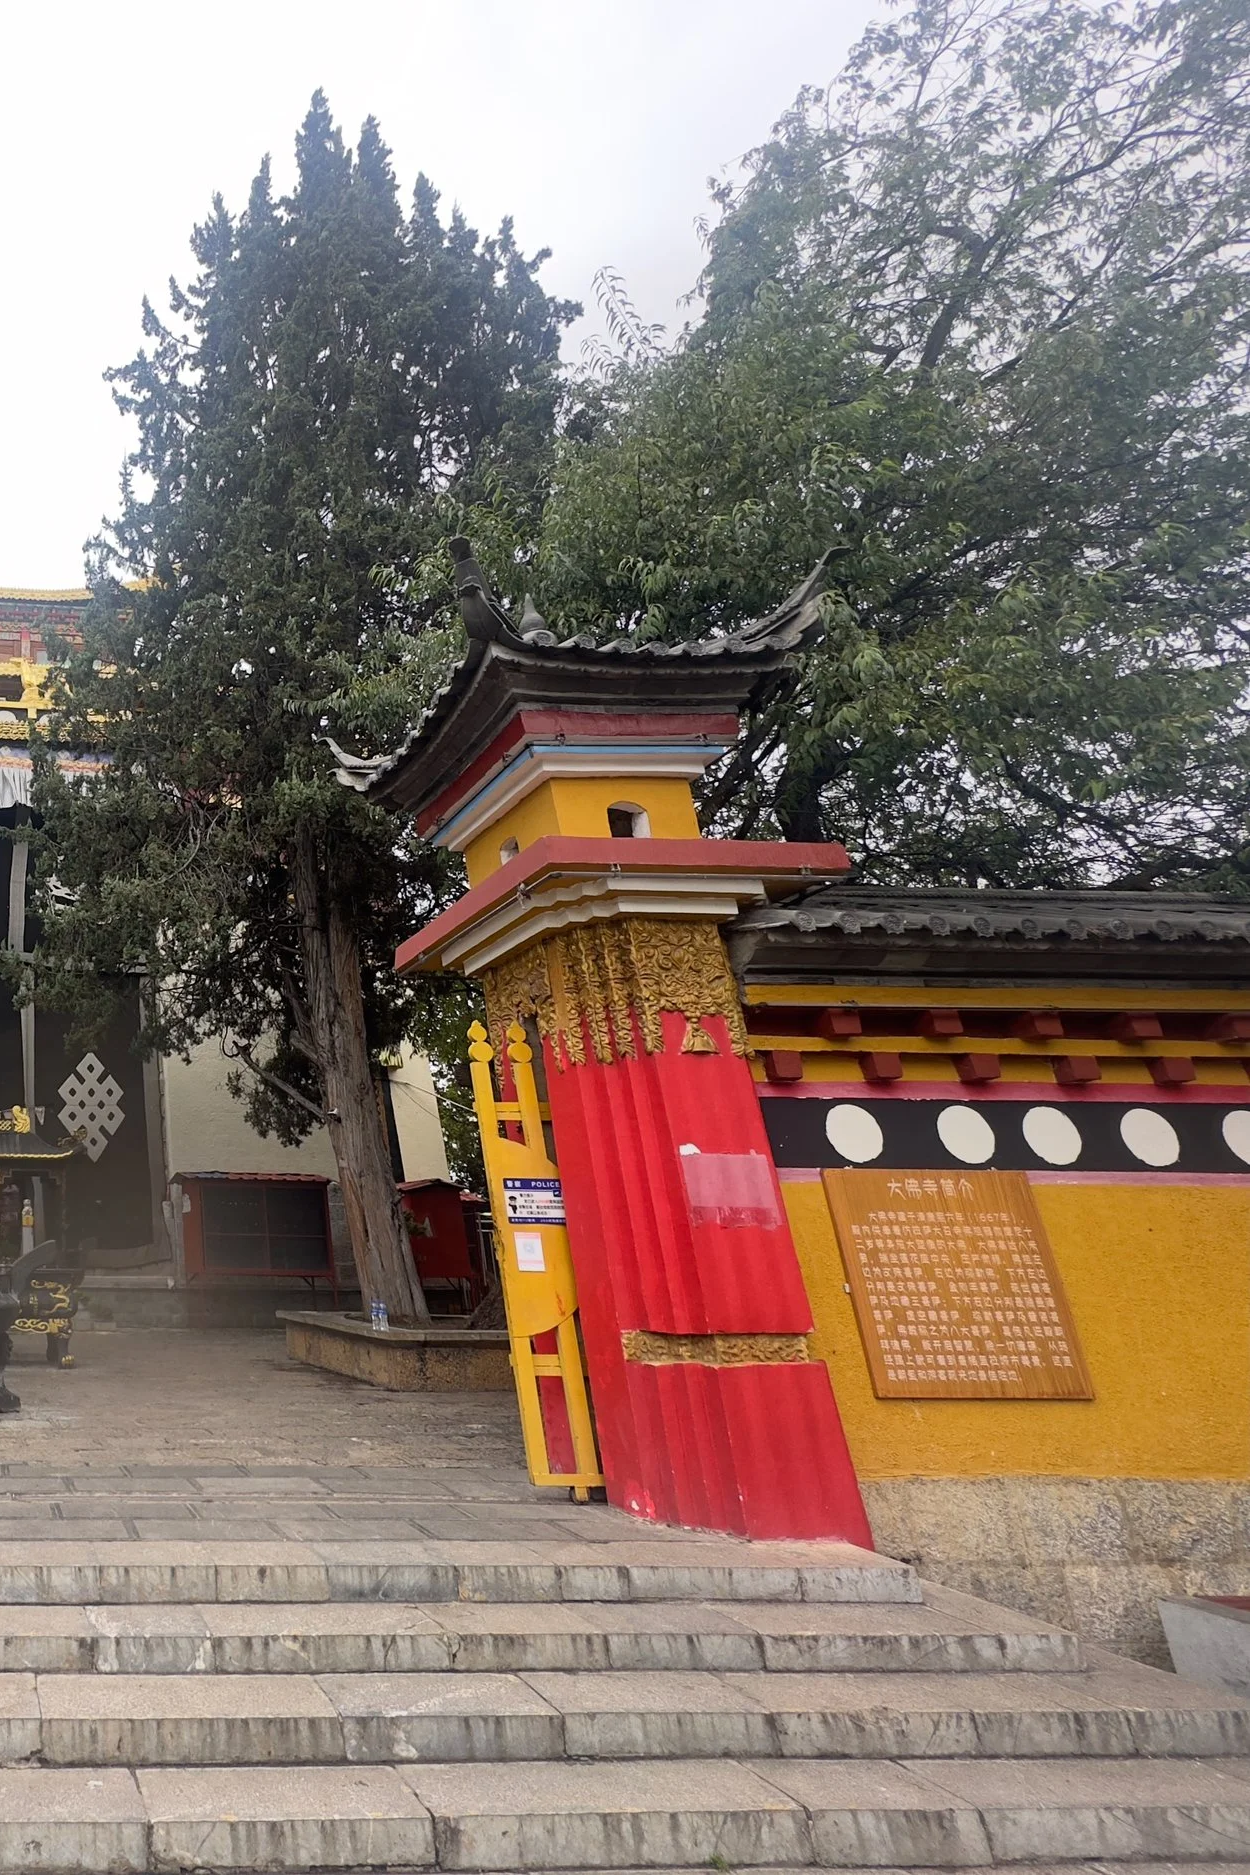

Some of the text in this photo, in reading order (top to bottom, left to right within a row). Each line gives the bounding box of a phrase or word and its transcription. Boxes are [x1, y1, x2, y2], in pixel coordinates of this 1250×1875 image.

[886, 1177, 975, 1201] 大佛寺简介
